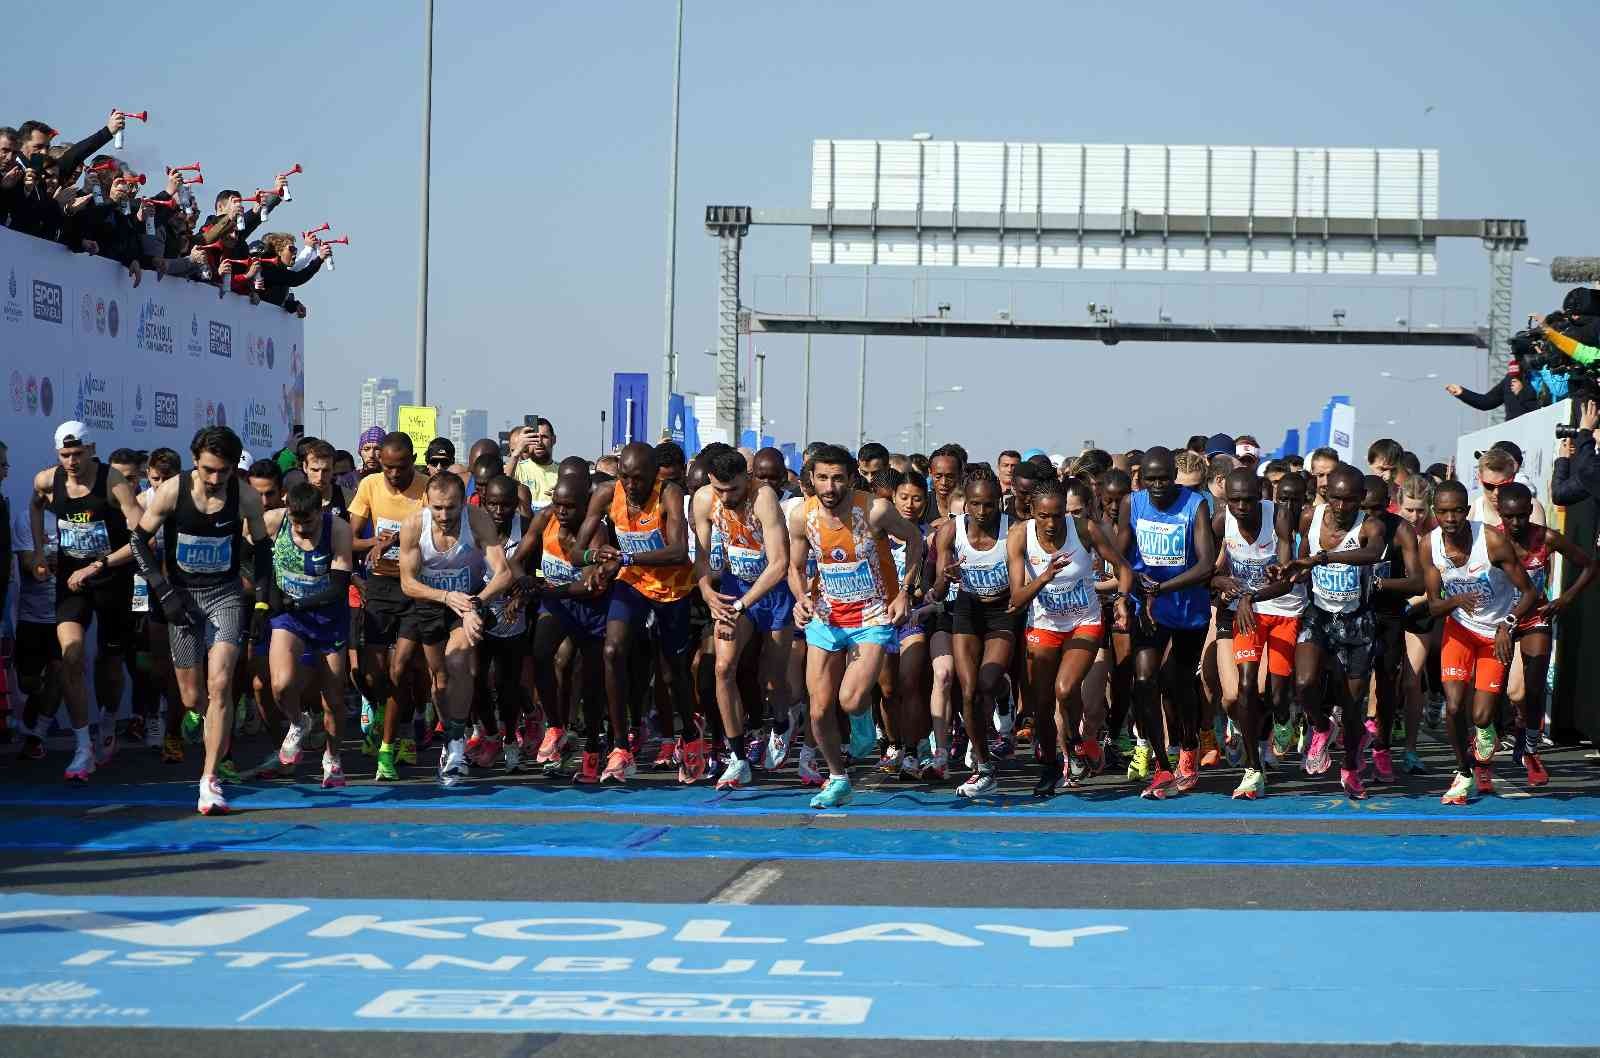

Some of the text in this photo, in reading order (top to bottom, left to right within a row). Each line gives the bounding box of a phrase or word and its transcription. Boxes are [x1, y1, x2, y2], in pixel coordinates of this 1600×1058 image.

[34, 284, 60, 305] SPOR
[1137, 531, 1170, 555] DAVID
[307, 915, 1129, 948] KOLAY
[61, 950, 844, 977] ISTANBUL
[410, 992, 829, 1010] SPOR
